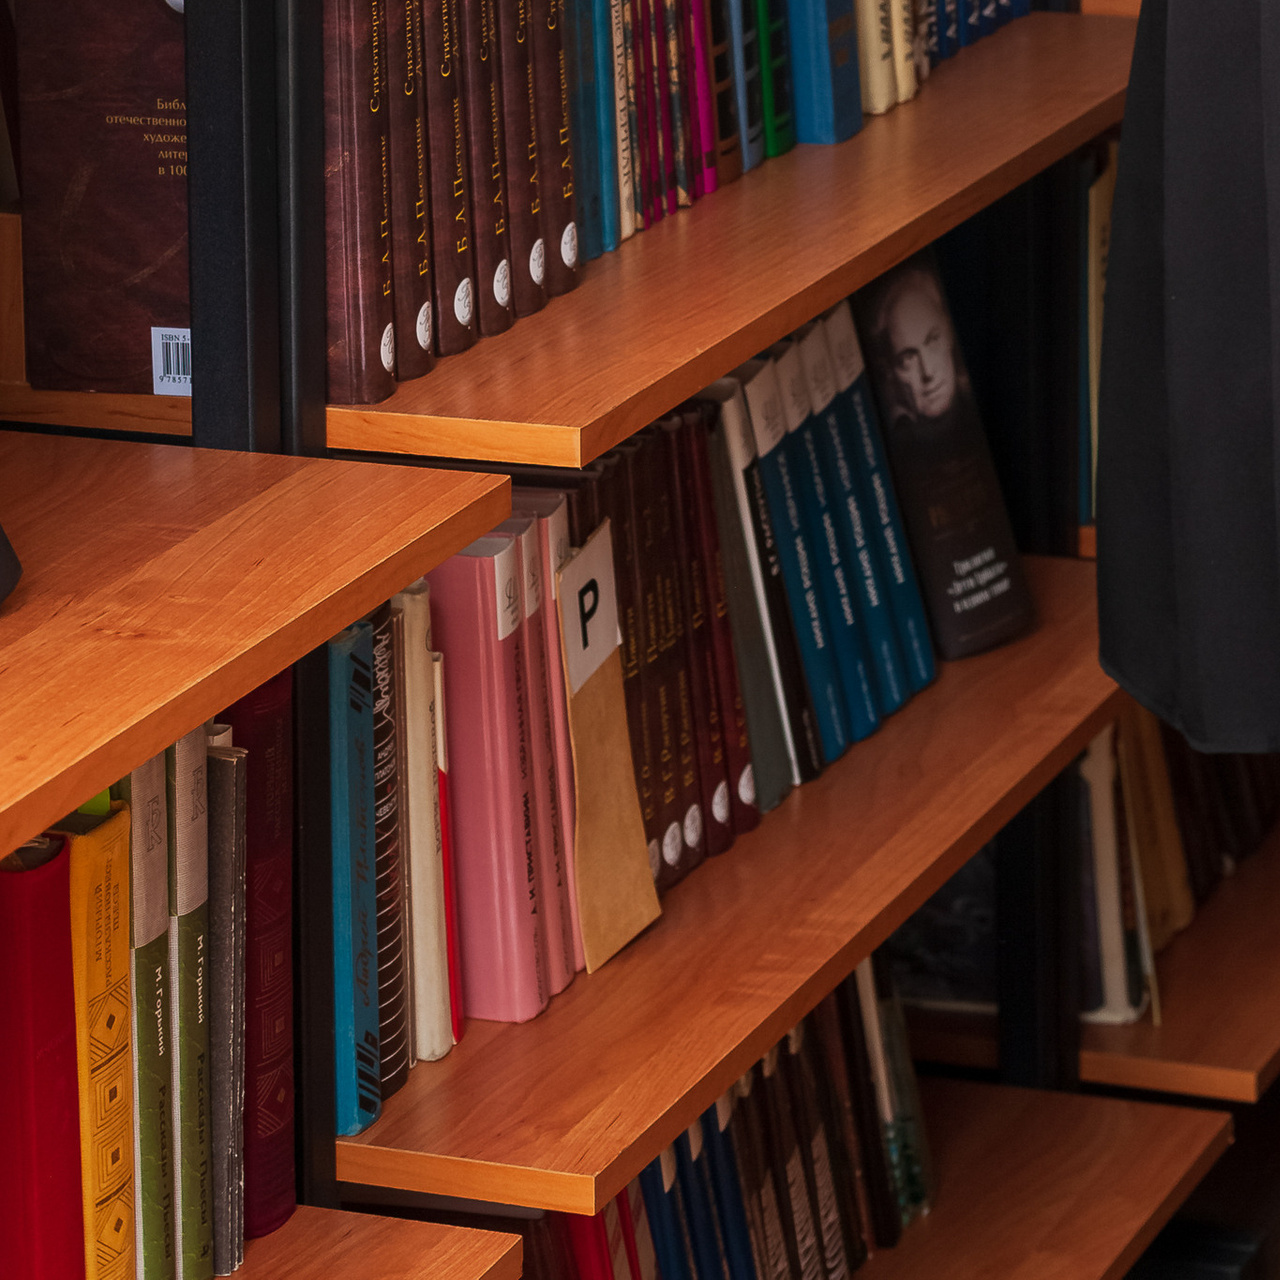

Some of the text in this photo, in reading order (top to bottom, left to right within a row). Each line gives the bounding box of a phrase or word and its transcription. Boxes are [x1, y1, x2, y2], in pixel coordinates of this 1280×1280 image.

[105, 115, 187, 128] отечественно
[143, 133, 187, 146] художе
[490, 80, 502, 182] Пастернак
[558, 48, 571, 148] Пастернак
[453, 97, 465, 199] Пастернак
[161, 334, 180, 342] ISBN
[577, 578, 600, 651] Р
[520, 790, 537, 881] ПРИСТАВКИН
[154, 965, 165, 1057] М.Горький
[196, 934, 205, 1025] М.Горький
